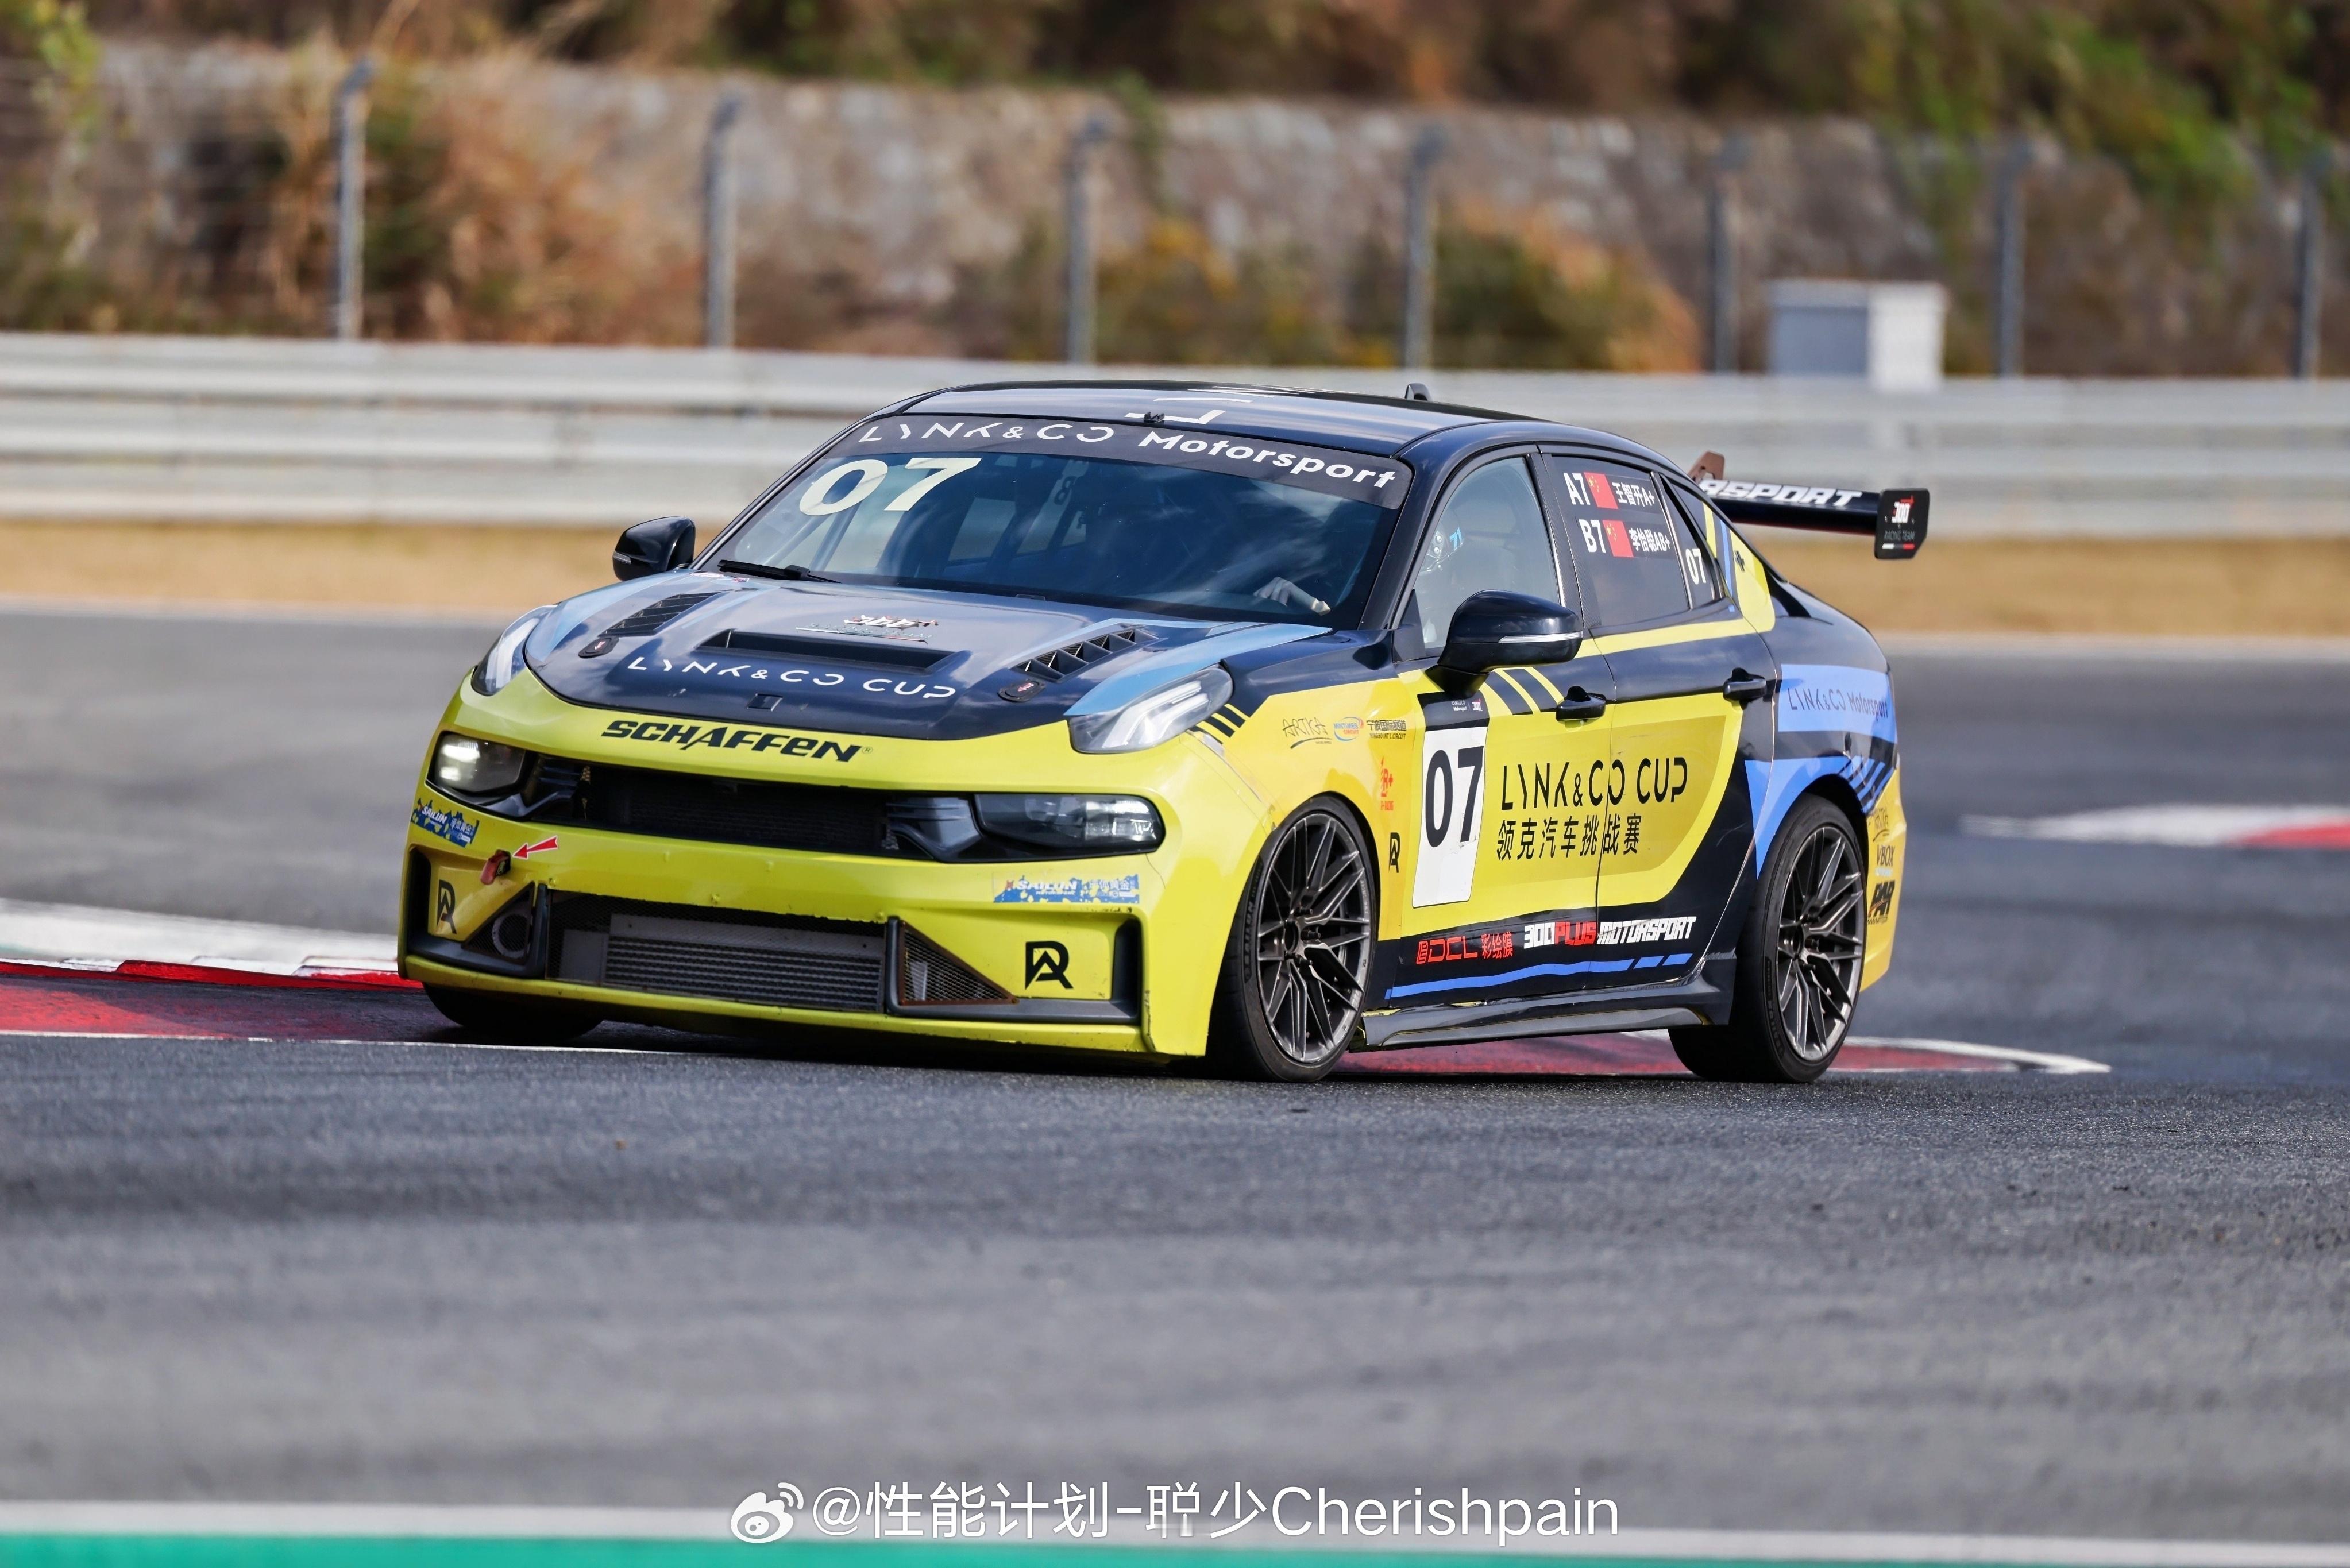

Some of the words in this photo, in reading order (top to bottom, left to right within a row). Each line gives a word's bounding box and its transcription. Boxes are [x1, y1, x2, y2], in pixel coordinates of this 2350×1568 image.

[1138, 430, 1395, 489] Motorsport
[799, 457, 982, 516] 07
[1563, 472, 1591, 505] A7
[1579, 519, 1607, 553] B7
[1685, 547, 1707, 585] 07
[863, 678, 956, 699] CUP
[1425, 746, 1484, 848] 07
[1637, 756, 1688, 804] CUP
[422, 806, 448, 824] SAILUN
[1496, 812, 1642, 861] 领克汽车挑战赛
[1877, 844, 1895, 867] VBOX
[1481, 932, 1513, 959] 彩绘膜
